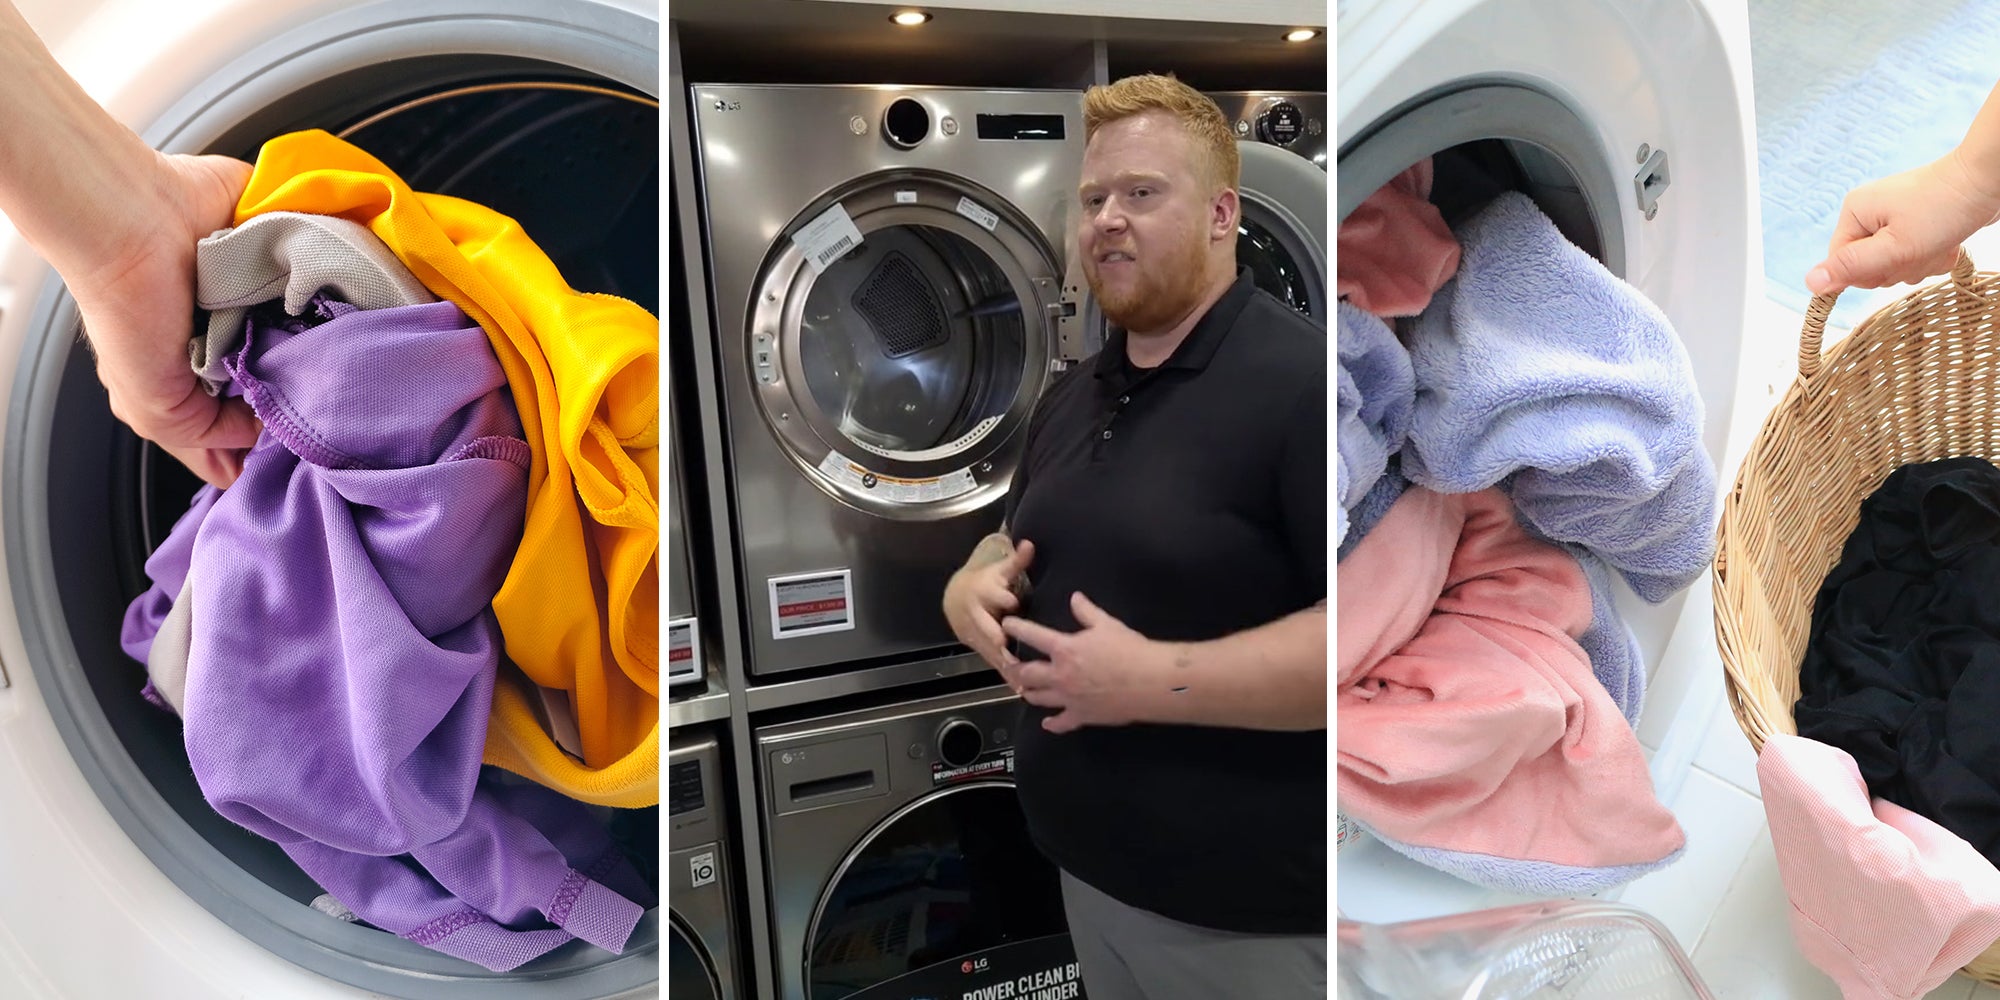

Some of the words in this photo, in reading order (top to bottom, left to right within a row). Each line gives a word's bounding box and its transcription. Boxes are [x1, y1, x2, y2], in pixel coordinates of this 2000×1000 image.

[933, 767, 968, 780] INFORMATION
[975, 763, 991, 771] EVERY
[974, 958, 988, 969] LG
[963, 980, 1016, 1000] POWER
[1018, 966, 1064, 994] CLEAN
[1066, 962, 1080, 981] BI
[1032, 981, 1079, 1000] UNDER
